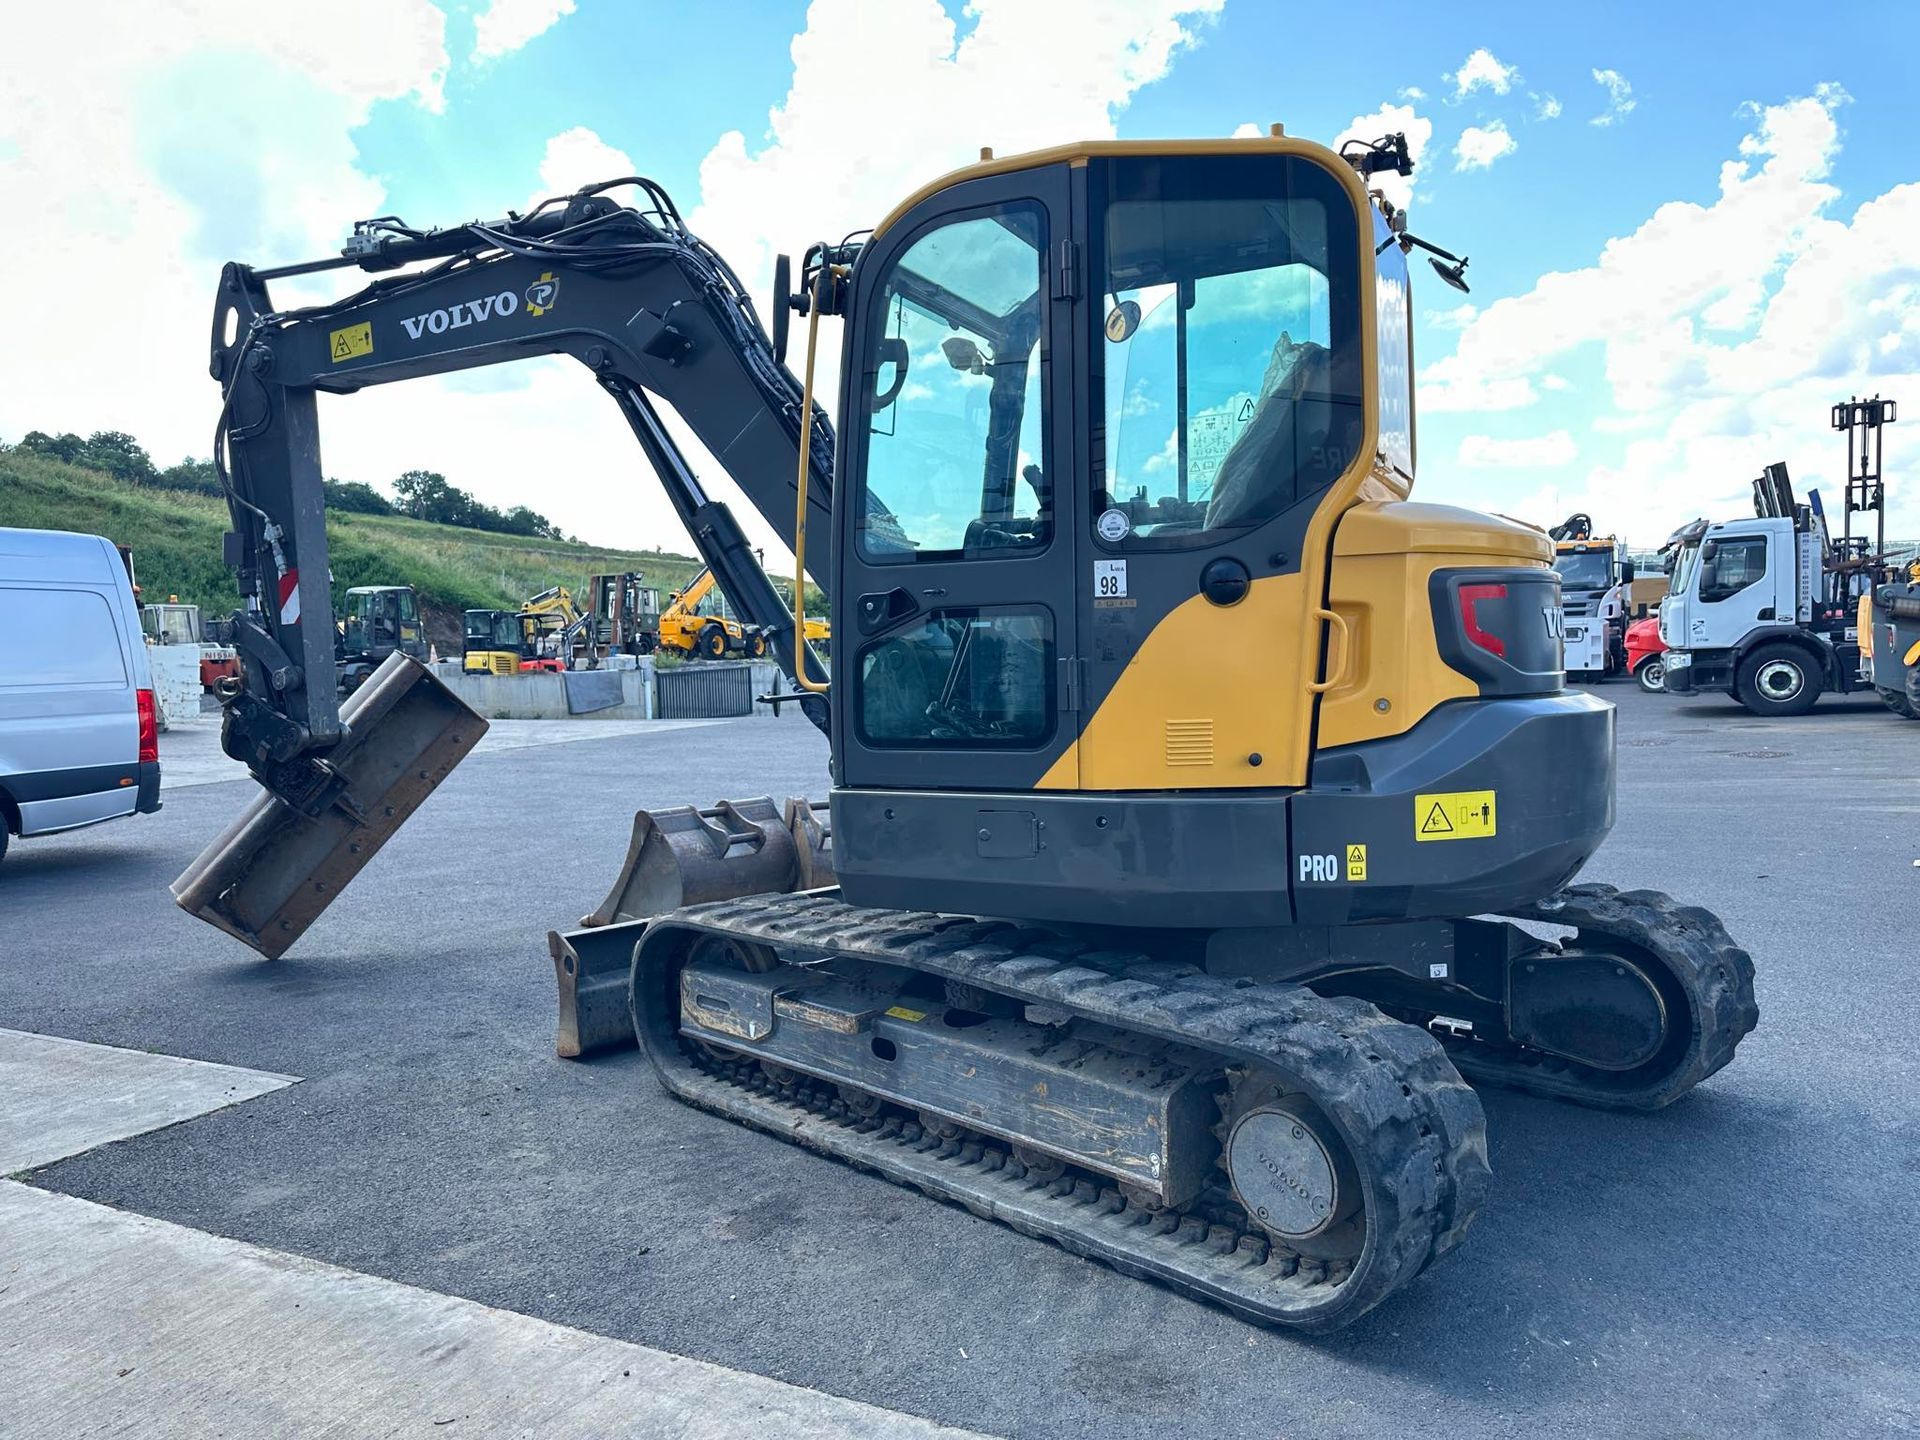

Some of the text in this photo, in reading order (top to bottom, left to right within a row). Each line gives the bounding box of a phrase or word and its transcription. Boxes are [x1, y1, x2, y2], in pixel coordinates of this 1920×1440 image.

[400, 291, 518, 340] VOLVO
[1100, 576, 1118, 595] 98
[1299, 854, 1338, 881] PRO
[1258, 1151, 1309, 1199] VOLVO
